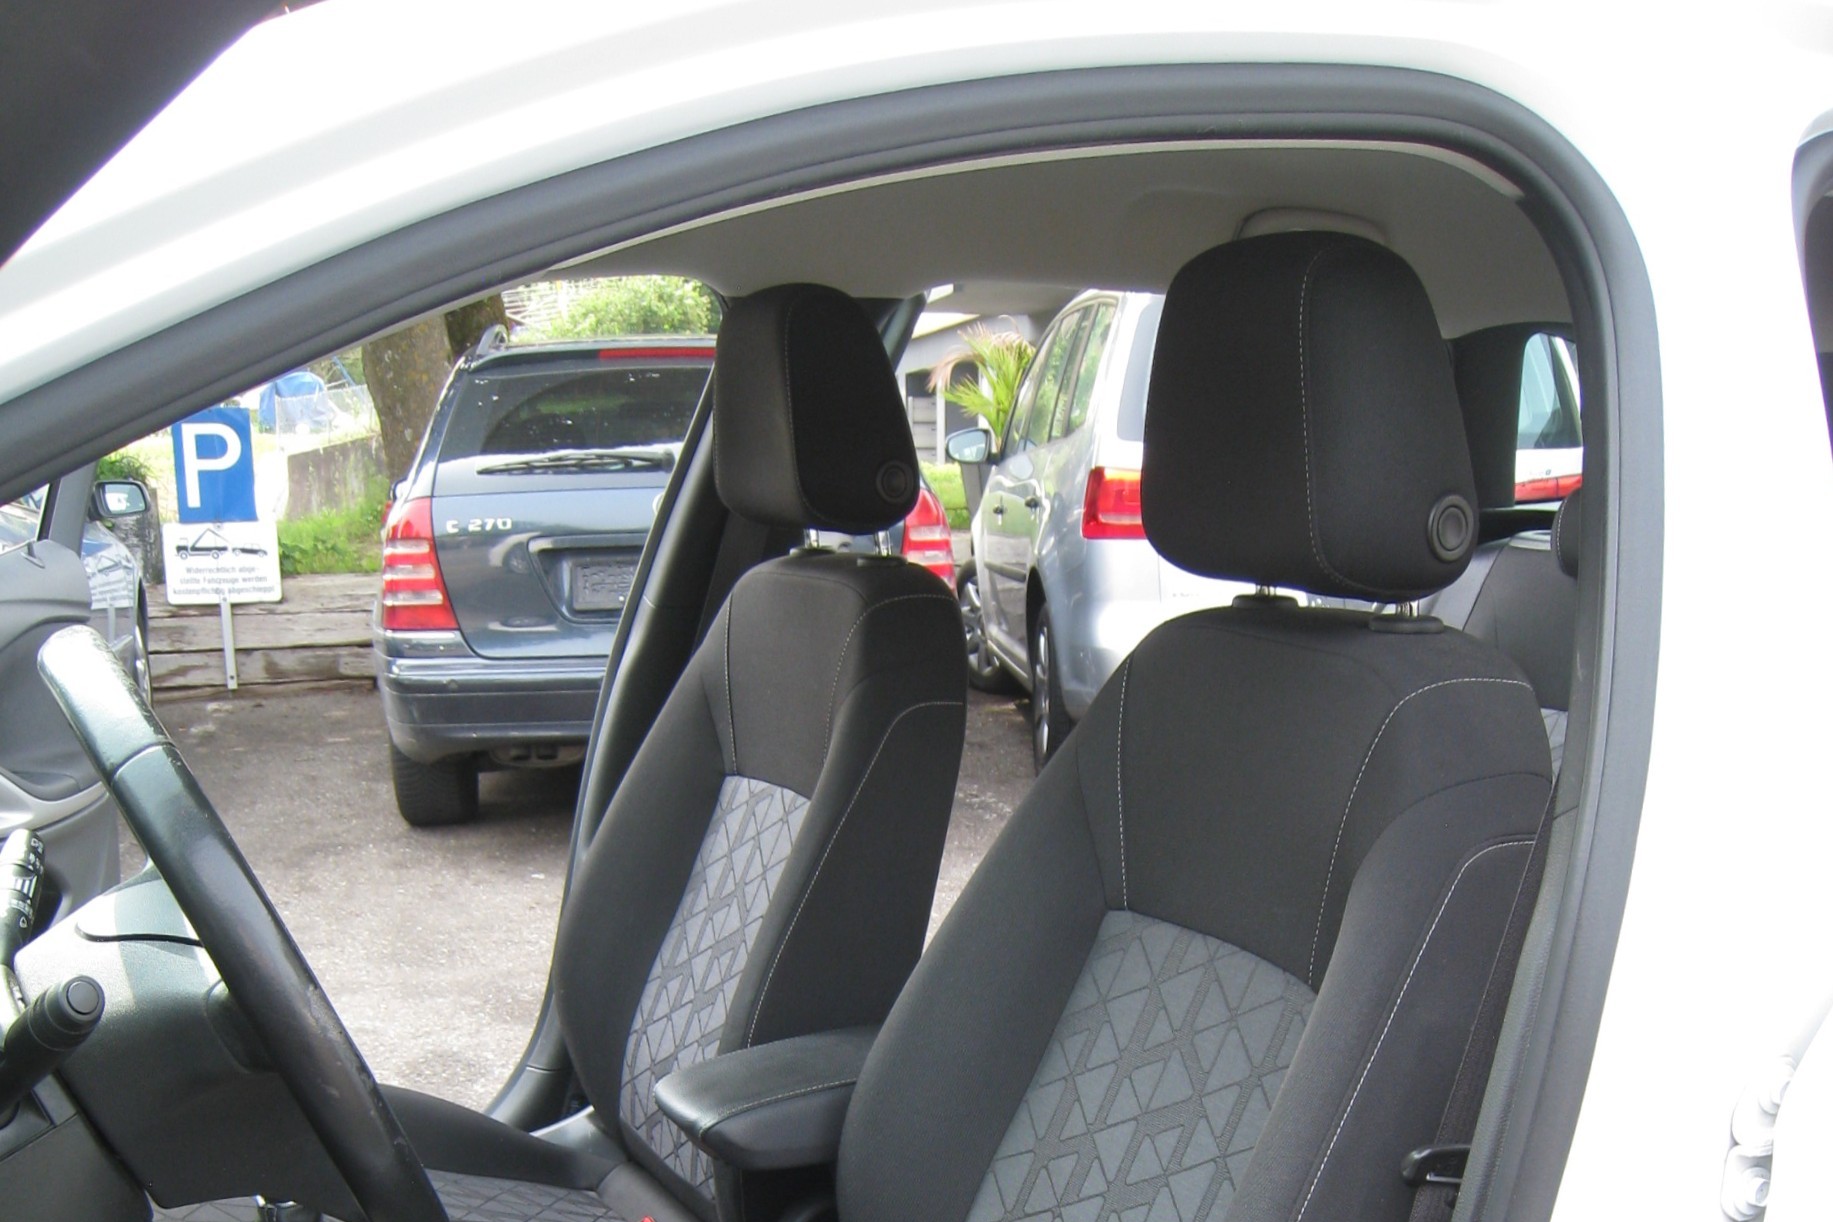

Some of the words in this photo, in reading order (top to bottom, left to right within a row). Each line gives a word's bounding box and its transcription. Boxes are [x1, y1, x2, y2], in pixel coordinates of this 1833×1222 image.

[181, 423, 241, 508] P
[446, 519, 459, 533] C
[468, 518, 512, 532] 270
